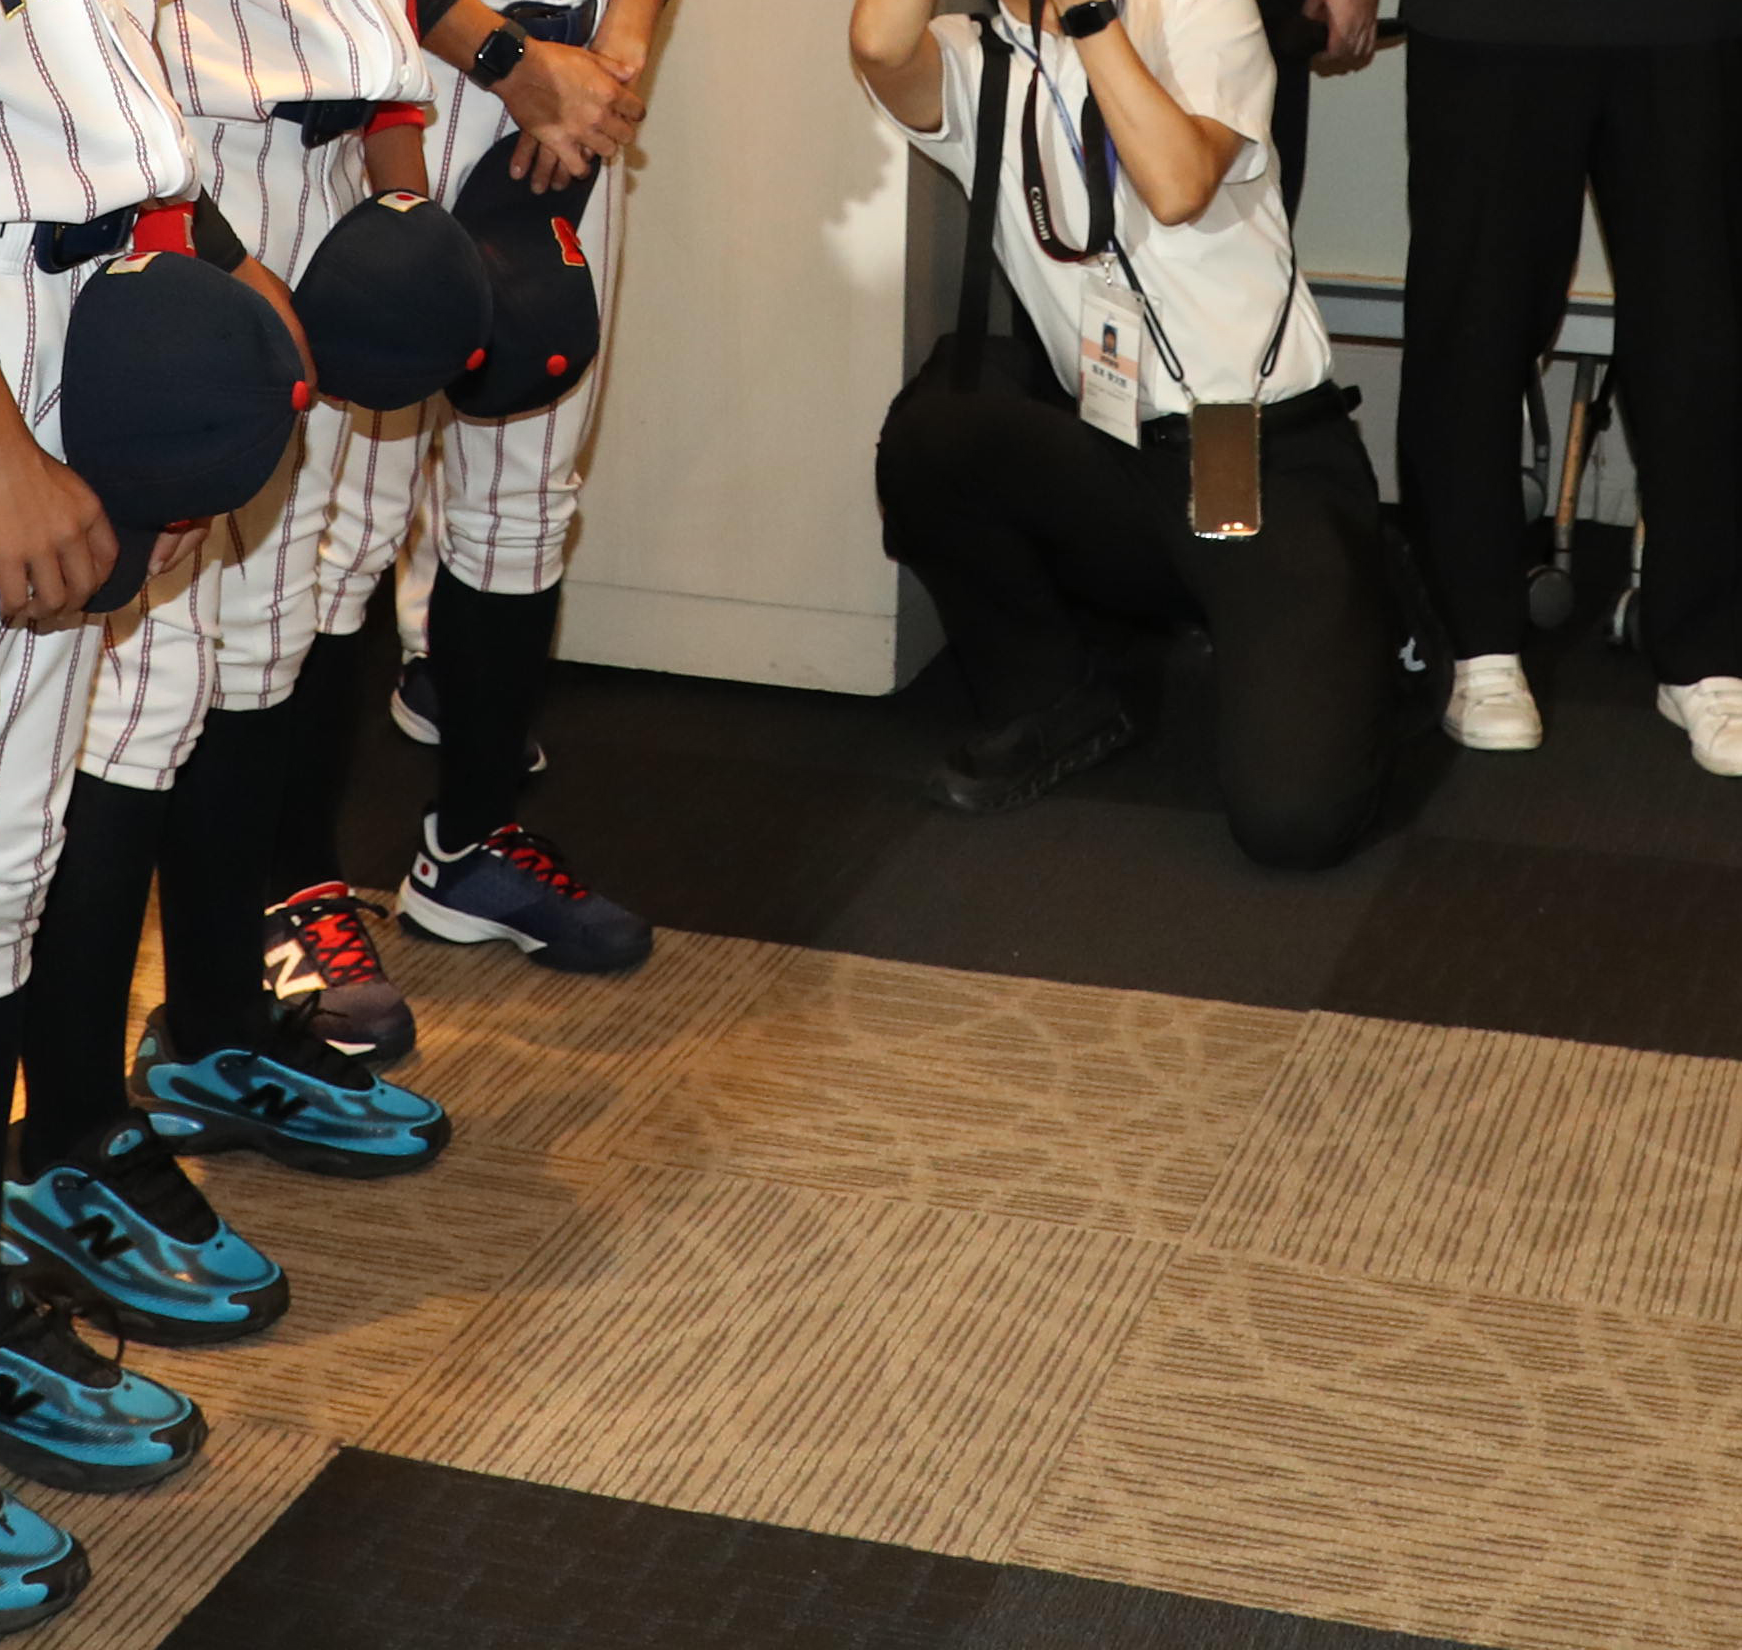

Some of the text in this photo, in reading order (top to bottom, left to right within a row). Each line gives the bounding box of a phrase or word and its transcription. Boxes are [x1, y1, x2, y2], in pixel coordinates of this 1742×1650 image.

[1029, 186, 1051, 240] Canon
[239, 1083, 308, 1123] N
[66, 1213, 138, 1262] N
